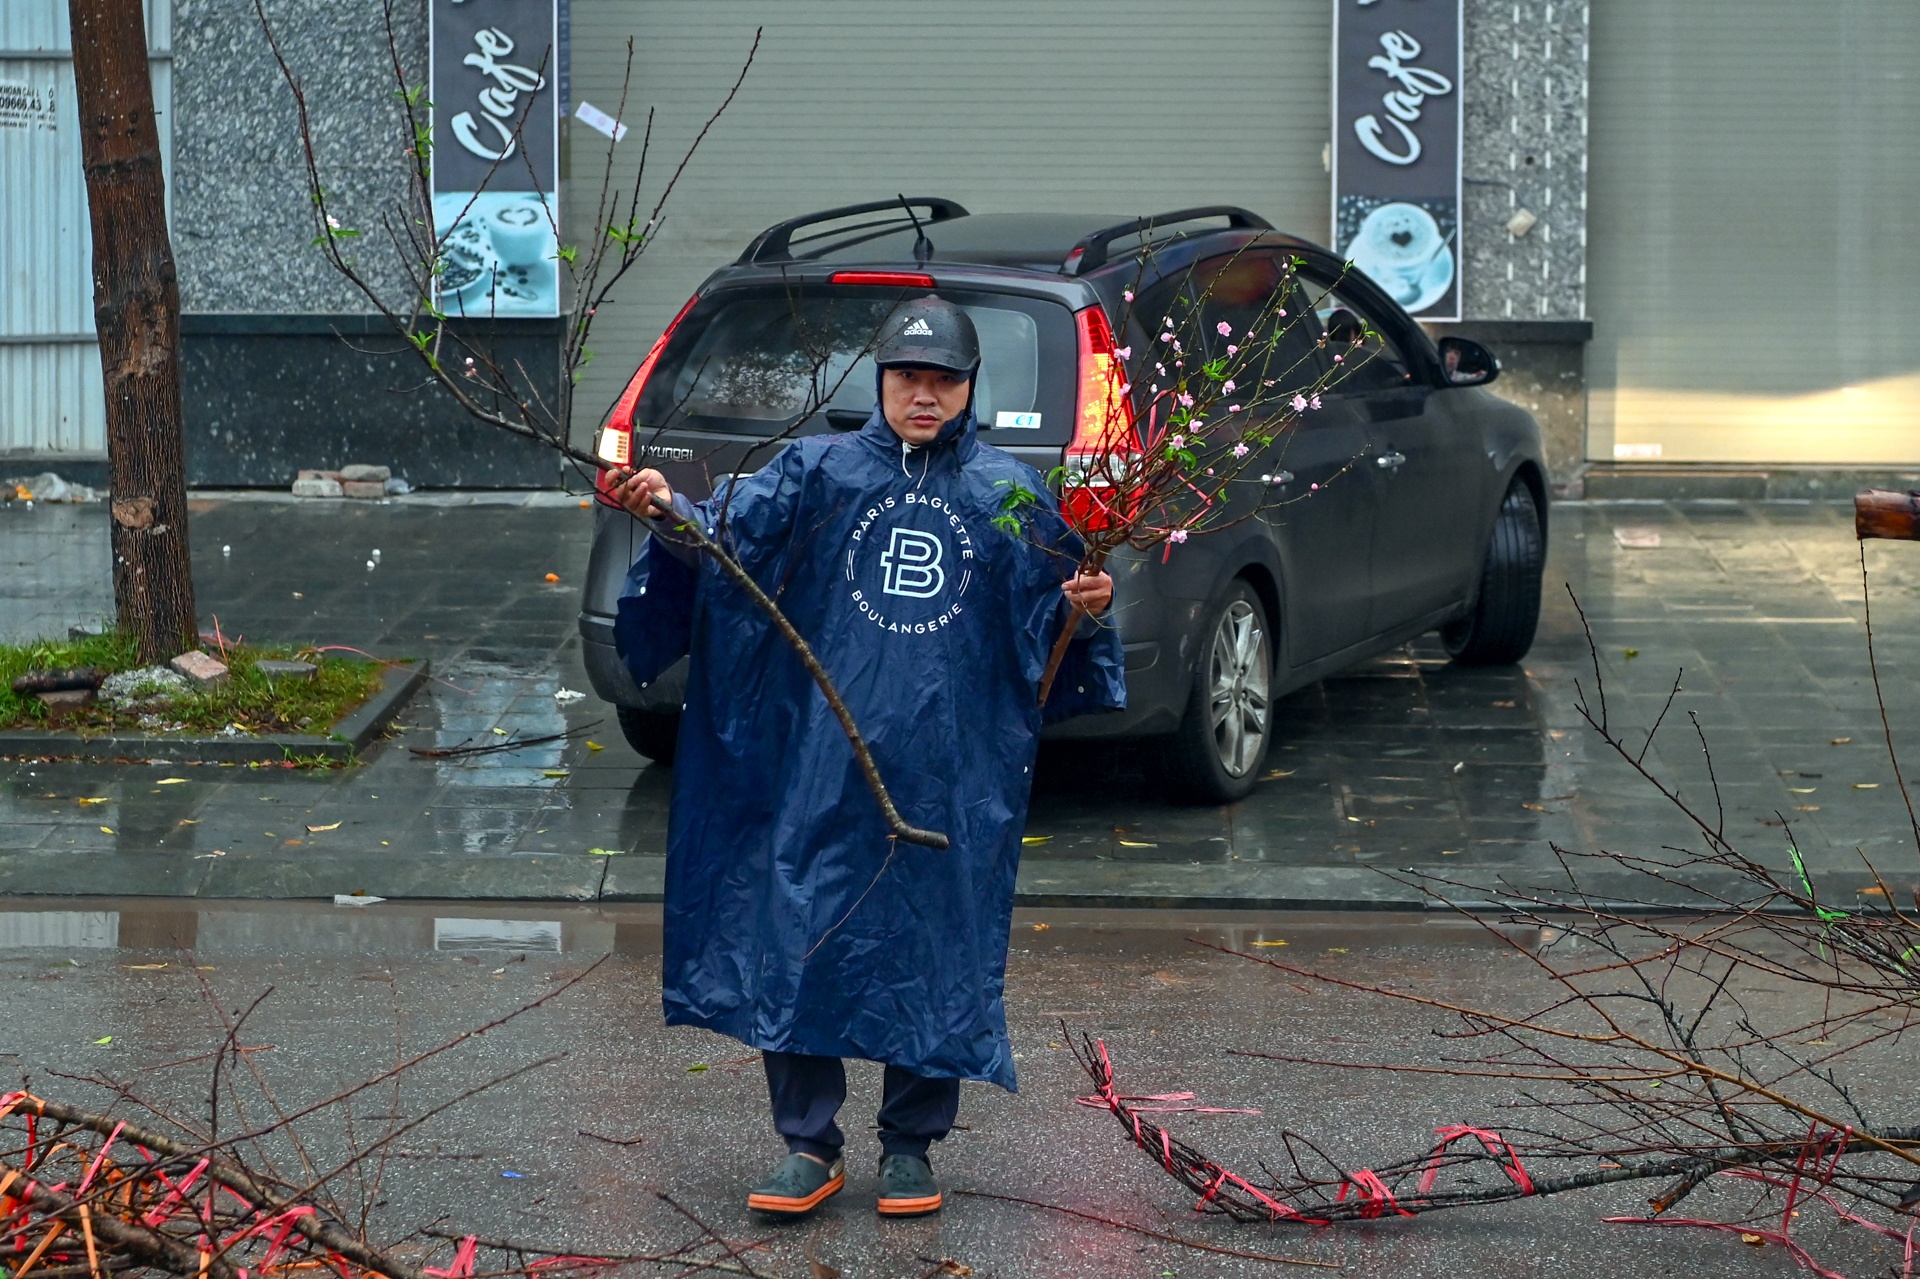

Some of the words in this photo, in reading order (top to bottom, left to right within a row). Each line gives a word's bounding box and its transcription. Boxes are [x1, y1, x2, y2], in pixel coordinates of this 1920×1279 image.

[452, 27, 545, 161] Cafe
[1354, 29, 1453, 165] Cafe
[903, 328, 933, 336] adidas
[641, 445, 693, 460] HYUNDAI
[852, 496, 896, 541] PARIS
[905, 493, 974, 560] BAGUETTE
[851, 589, 963, 634] BOULANGERIE
